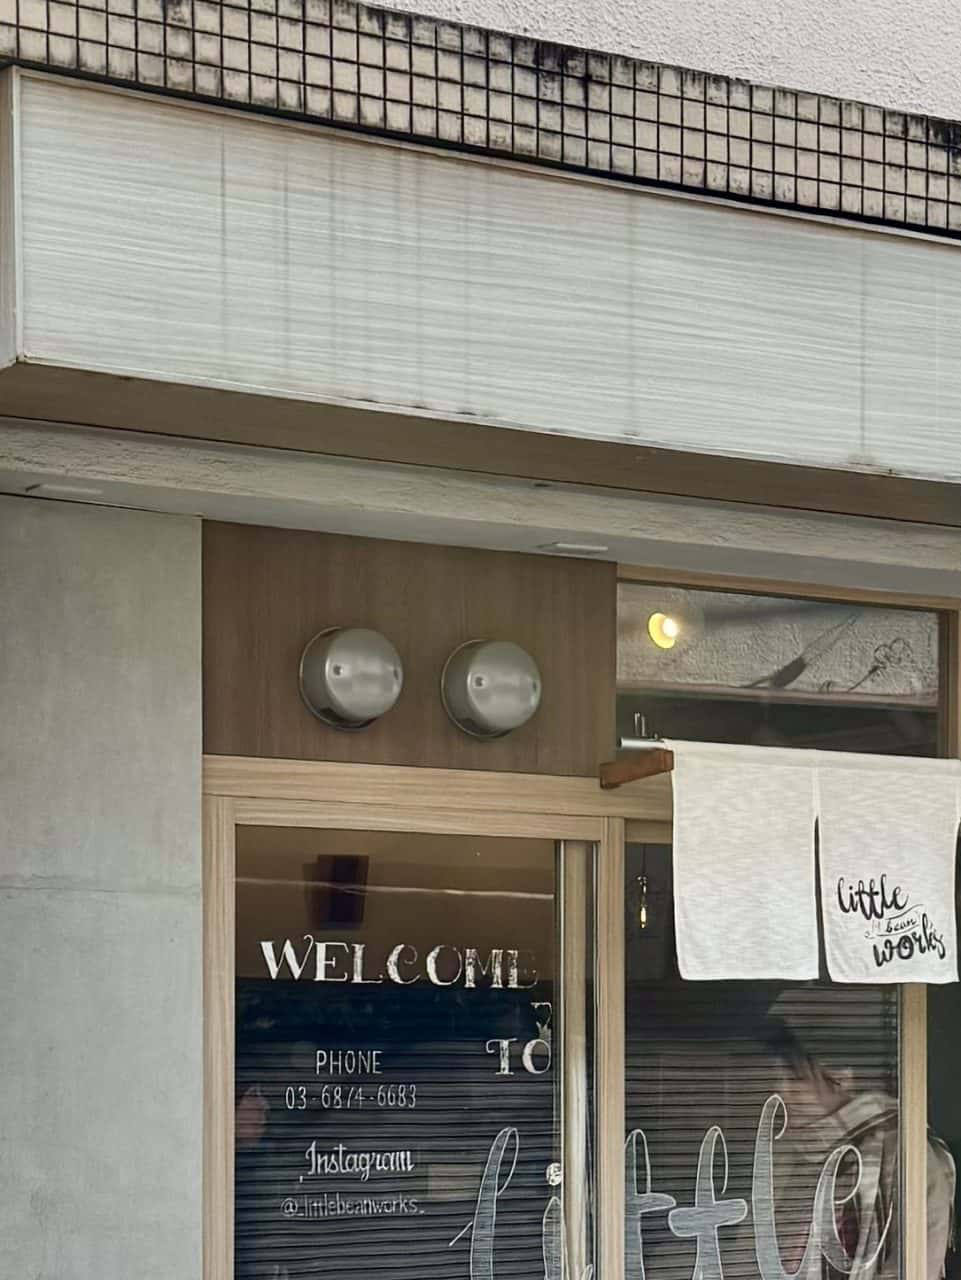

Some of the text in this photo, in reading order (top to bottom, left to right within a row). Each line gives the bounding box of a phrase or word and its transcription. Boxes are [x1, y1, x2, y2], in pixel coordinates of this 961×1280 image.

[838, 874, 909, 920] little
[259, 934, 539, 990] WELCOME
[873, 912, 946, 967] works
[315, 1050, 383, 1076] PHONE
[305, 1140, 416, 1182] Instagram
